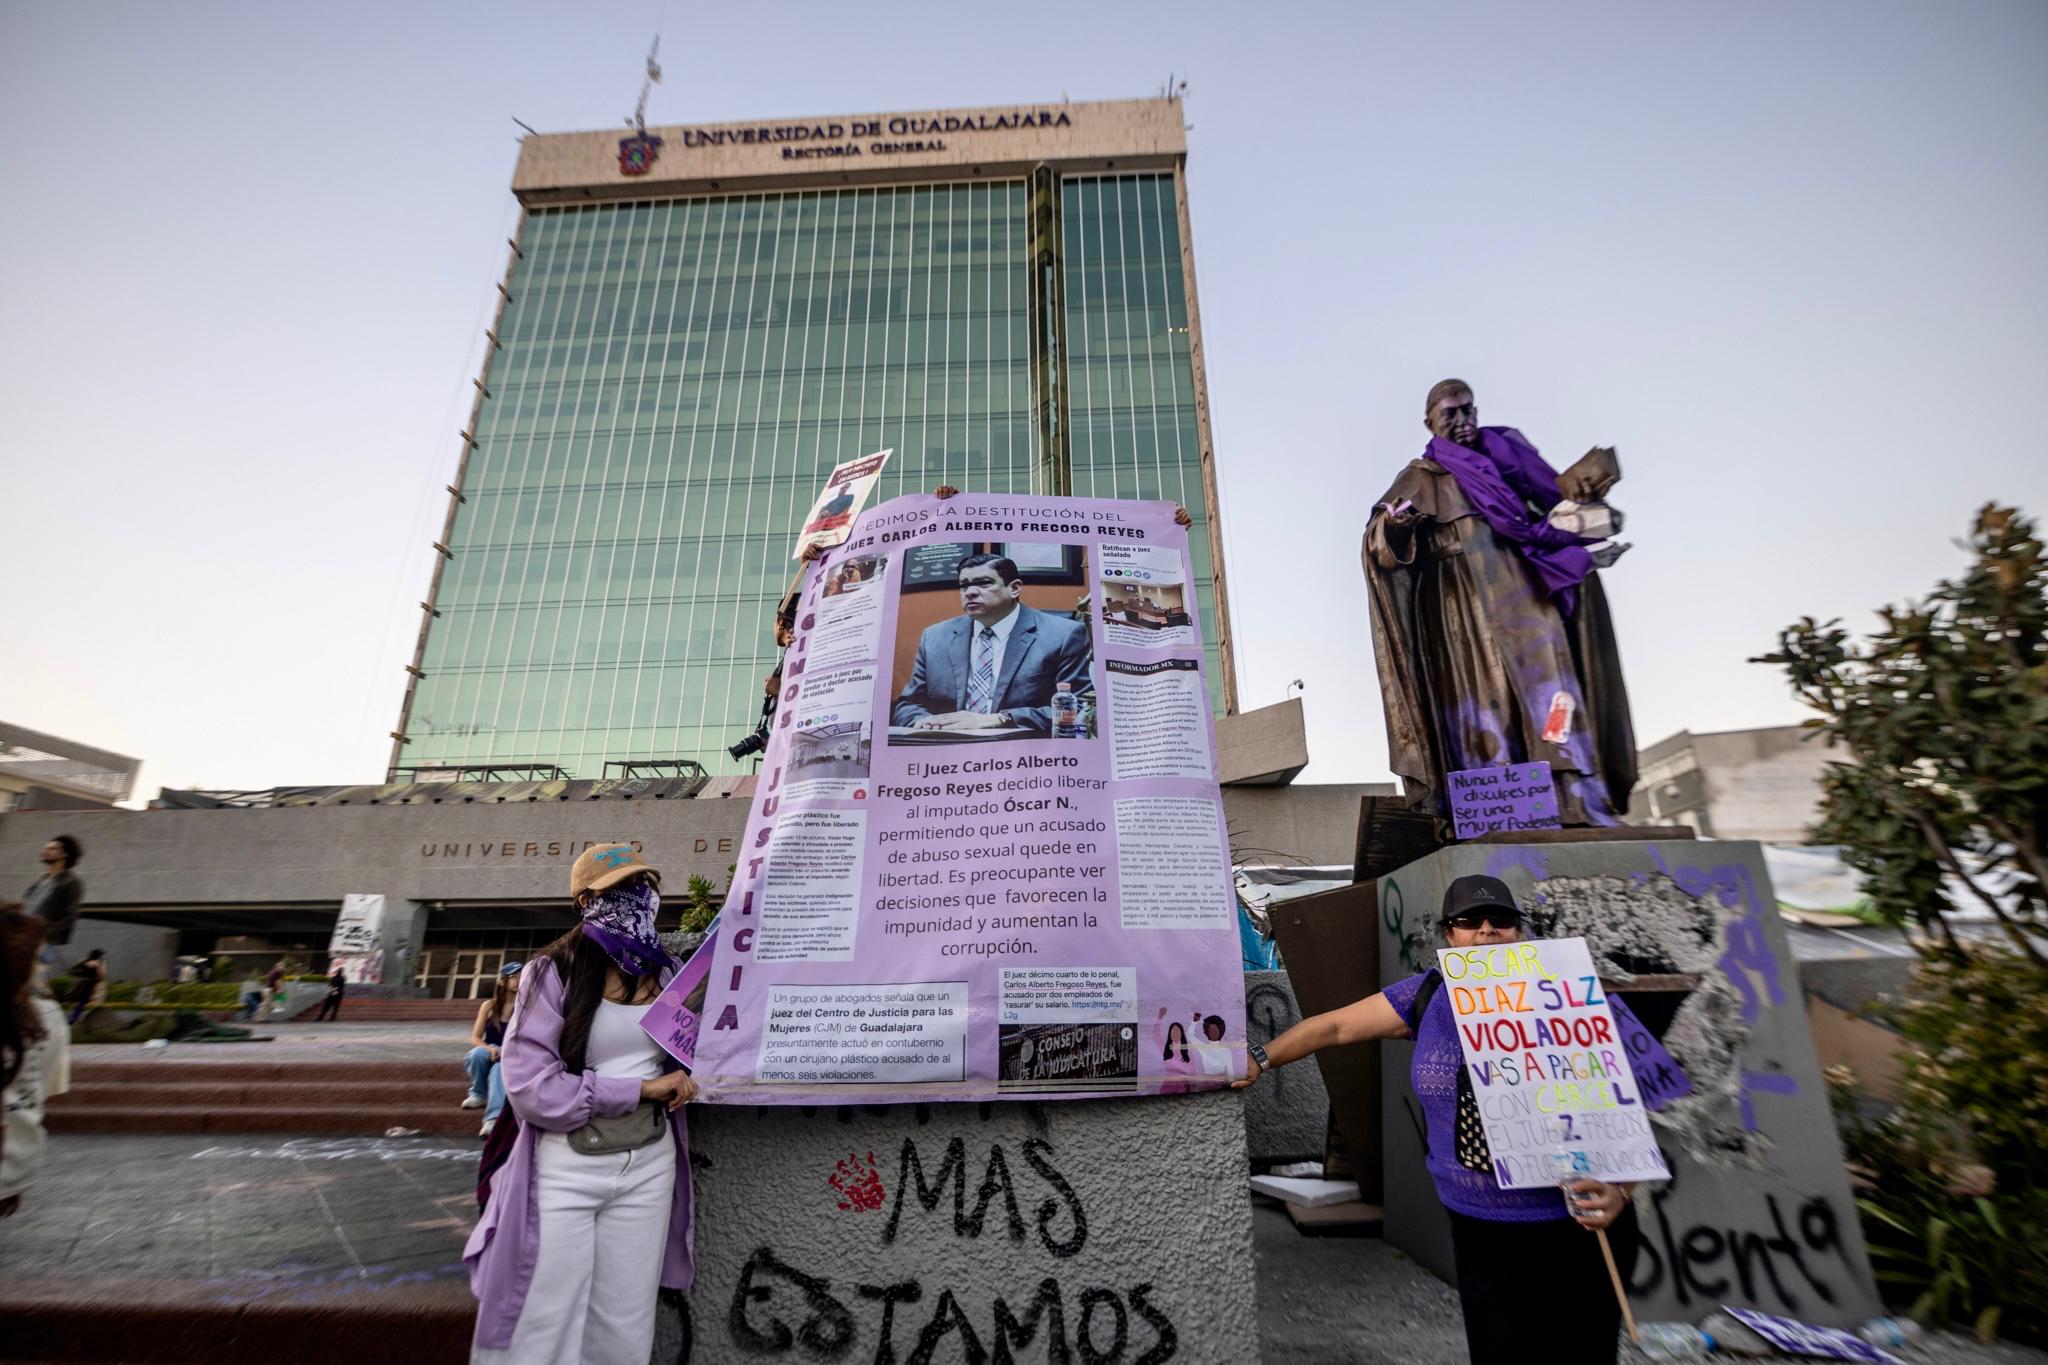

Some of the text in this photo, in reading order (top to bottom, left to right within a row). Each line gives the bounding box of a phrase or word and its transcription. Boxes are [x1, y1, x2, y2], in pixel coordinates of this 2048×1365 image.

[683, 111, 1071, 147] UNIVERSIDAD DE GUADALAJARA
[936, 506, 957, 517] LA
[965, 506, 1085, 519] DESTITUCIÓN
[1093, 512, 1126, 522] DEL
[845, 537, 874, 553] JUEZ
[881, 523, 937, 543] CARLOS
[945, 522, 1013, 531] ALBERTO
[1098, 526, 1145, 538] REYES
[1102, 544, 1131, 552] Ratifican
[827, 678, 846, 687] doctor
[848, 674, 873, 684] acusado
[838, 669, 851, 678] juez
[852, 668, 863, 676] por
[801, 692, 809, 700] de
[907, 755, 1079, 778] El Juez Carlos Alberto
[877, 784, 941, 800] Fregoso
[946, 781, 993, 797] Reyes
[997, 776, 1053, 791] decidio
[1057, 775, 1108, 790] liberar
[1454, 768, 1520, 789] Nunca te
[1464, 784, 1551, 802] disculpes por
[906, 797, 1078, 820] al imputado Óscar N.,
[1483, 805, 1514, 817] una
[879, 818, 1106, 845] permitiendo que un acusado
[694, 837, 733, 853] DE
[888, 841, 1096, 864] de abuso sexual quede en
[878, 865, 1106, 887] libertad. Es preocupante ver
[713, 766, 782, 1031] JUSTICIA
[876, 887, 1107, 910] decisiones que favorecen la
[884, 912, 1097, 937] impunidad y aumentan la
[941, 938, 1037, 958] corrupción.
[1444, 943, 1559, 981] OSCAR
[1003, 971, 1011, 979] El
[1011, 971, 1027, 980] juez
[1028, 970, 1055, 978] décimo
[1079, 970, 1089, 978] de
[1090, 970, 1098, 978] lo
[1098, 970, 1120, 979] penal,
[1003, 980, 1027, 989] Carlos
[1028, 980, 1054, 989] Alberto
[1055, 981, 1084, 990] Fregoso
[1085, 981, 1109, 990] Reyes,
[774, 992, 950, 1005] Un grupo de abogados señala que un
[1036, 992, 1047, 1000] por
[1049, 990, 1062, 998] dos
[1063, 990, 1103, 999] empleados
[1104, 990, 1113, 998] de
[1045, 1000, 1070, 1009] salario.
[1454, 975, 1604, 1015] DIAZ SLZ
[771, 1006, 954, 1020] juez del Centro de Justicia para las
[769, 1023, 923, 1035] Mujeres (CJM) de Guadalajara
[1462, 1014, 1613, 1052] VIOLADOR
[766, 1037, 944, 1050] presuntamente actuó en contubernio
[1038, 1027, 1084, 1053] CONSEJO
[784, 1055, 797, 1063] un
[799, 1053, 838, 1066] cirujano
[841, 1053, 879, 1066] plástico
[881, 1053, 924, 1064] acusado
[926, 1053, 939, 1064] de
[942, 1052, 951, 1063] al
[1019, 1067, 1031, 1080] DE
[1048, 1047, 1118, 1077] JUDICATURA
[1471, 1050, 1622, 1086] VAS A PAGAR
[762, 1069, 877, 1080] menos seis violaciones.
[1483, 1090, 1531, 1120] CON
[1535, 1082, 1636, 1113] CARCEL
[881, 1136, 1088, 1259] MAS
[729, 1246, 1179, 1365] ESTAMOS
